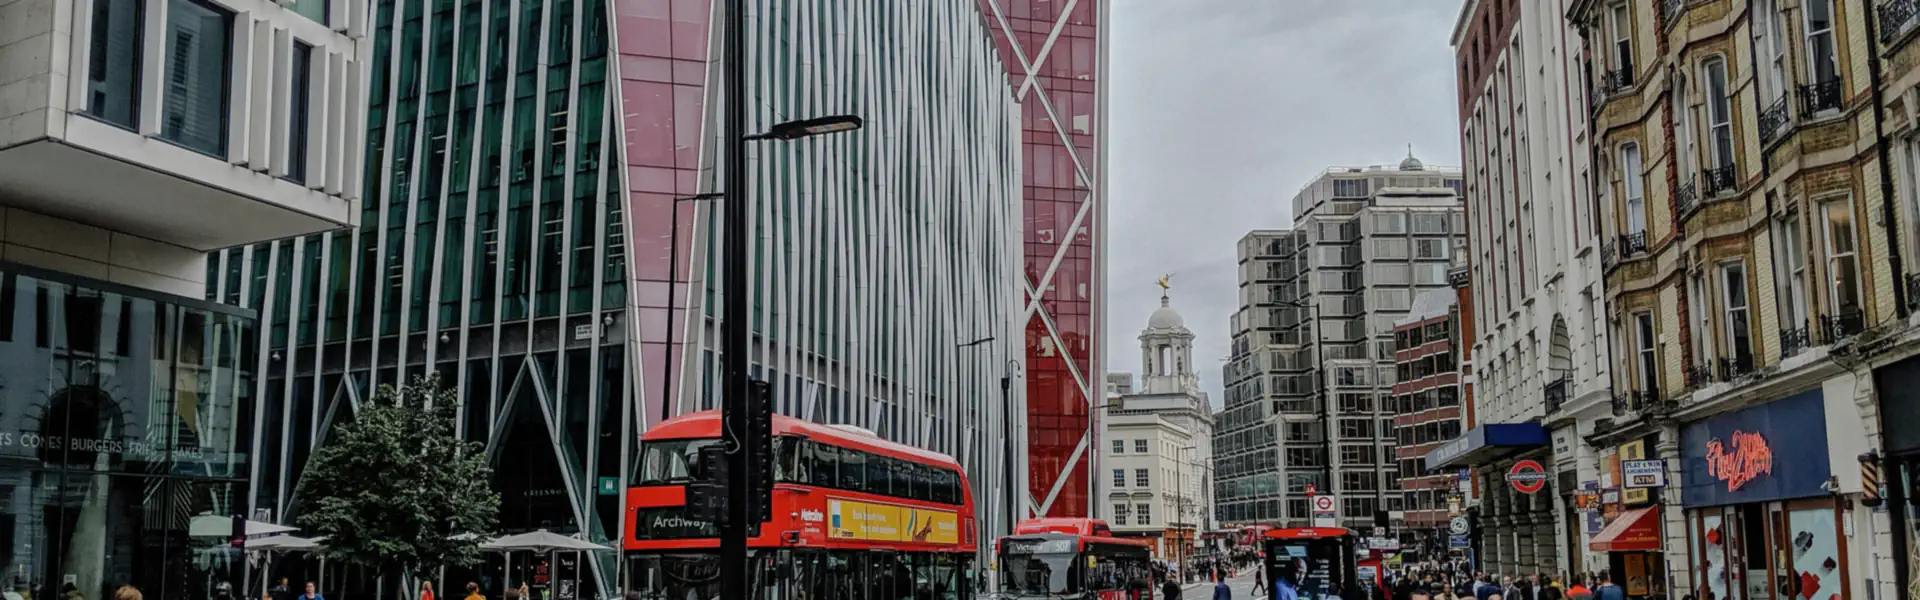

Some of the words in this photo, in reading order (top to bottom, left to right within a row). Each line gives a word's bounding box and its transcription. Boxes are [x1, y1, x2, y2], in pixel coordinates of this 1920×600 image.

[20, 434, 61, 449] CONES
[71, 438, 123, 453] BURGERS
[1634, 475, 1656, 484] ATM
[653, 515, 706, 530] Archway
[1055, 541, 1069, 553] 507
